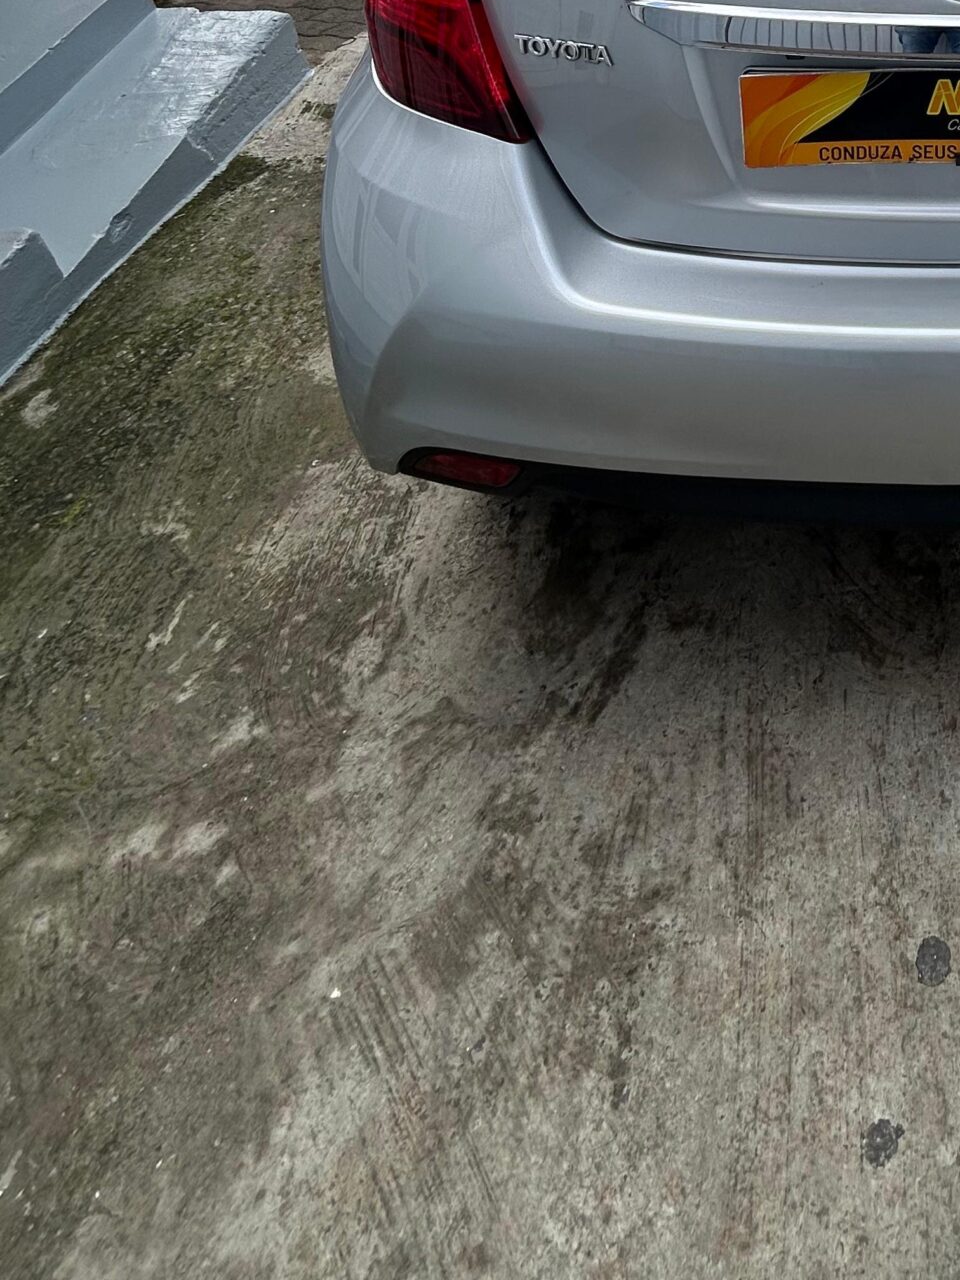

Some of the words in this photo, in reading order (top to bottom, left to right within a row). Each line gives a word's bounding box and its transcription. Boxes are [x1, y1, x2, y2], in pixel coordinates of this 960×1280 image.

[514, 33, 614, 67] TOYOTA
[819, 145, 902, 161] CONDUZA
[912, 144, 957, 160] SEUS
